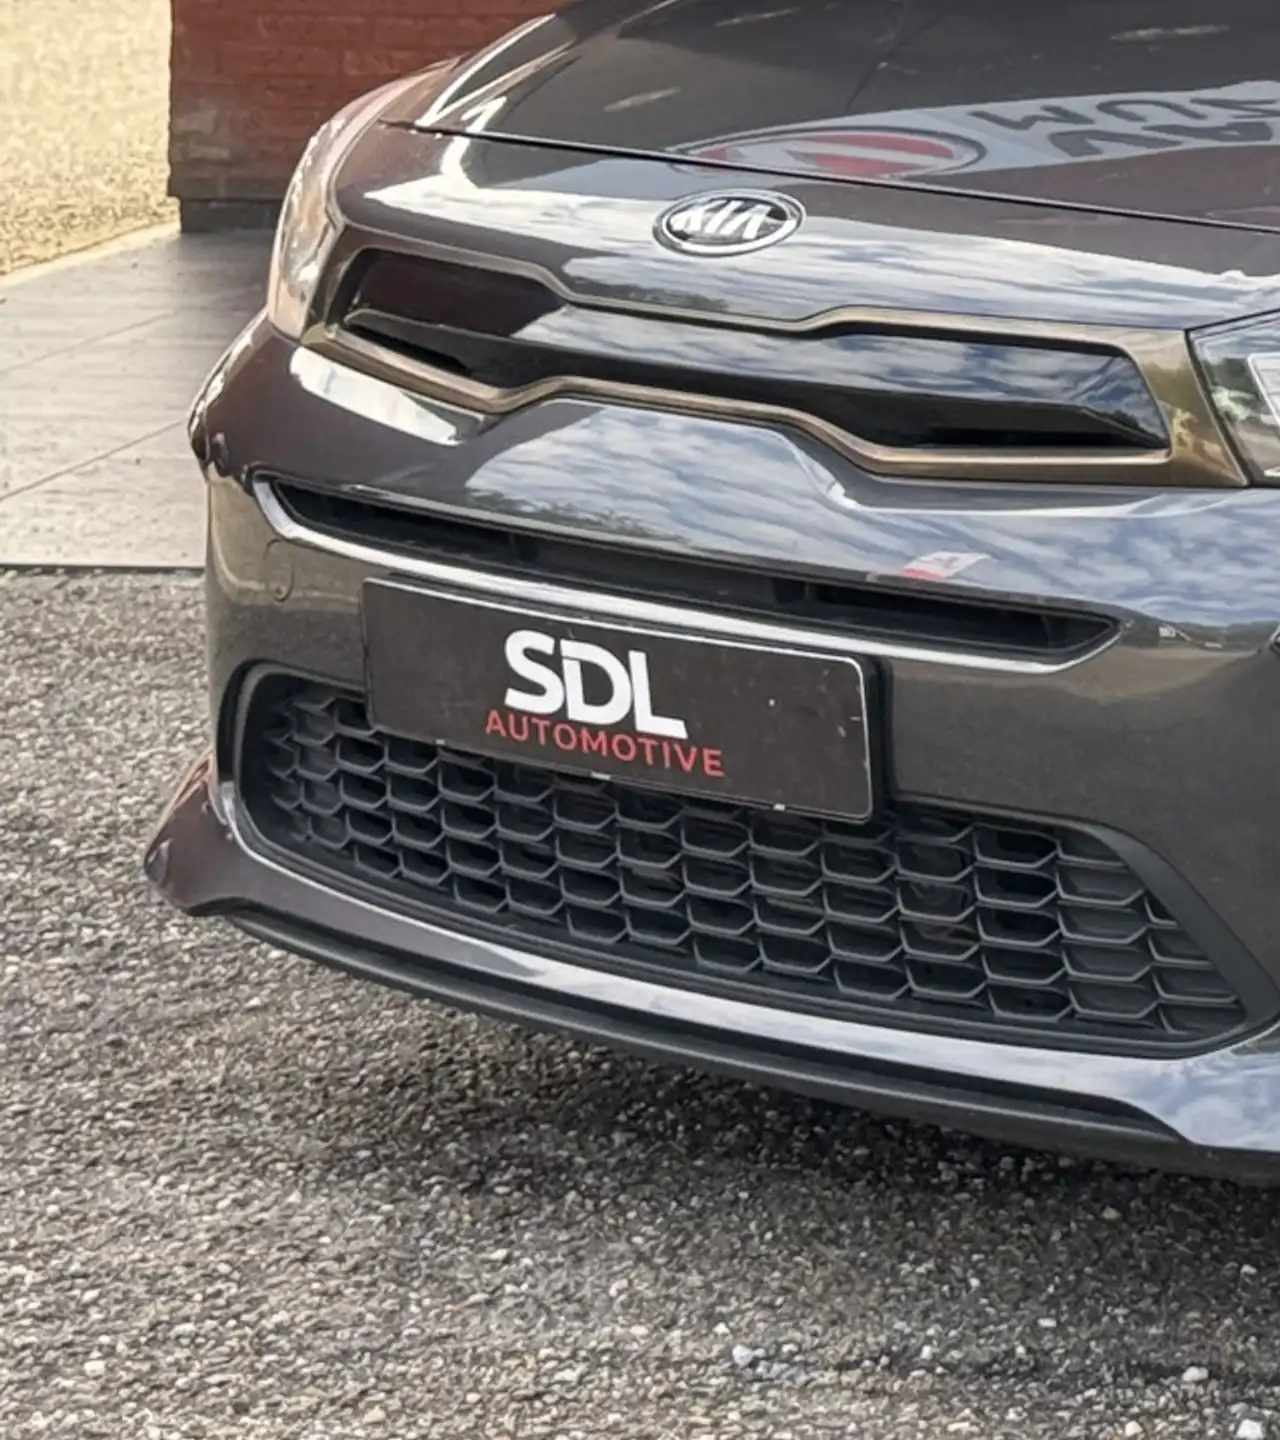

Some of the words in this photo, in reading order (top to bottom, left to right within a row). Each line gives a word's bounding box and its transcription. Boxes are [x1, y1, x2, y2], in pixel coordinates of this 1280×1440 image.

[670, 200, 772, 239] KIA
[505, 629, 689, 739] SDL
[485, 710, 725, 777] AUTOMOTIVE
